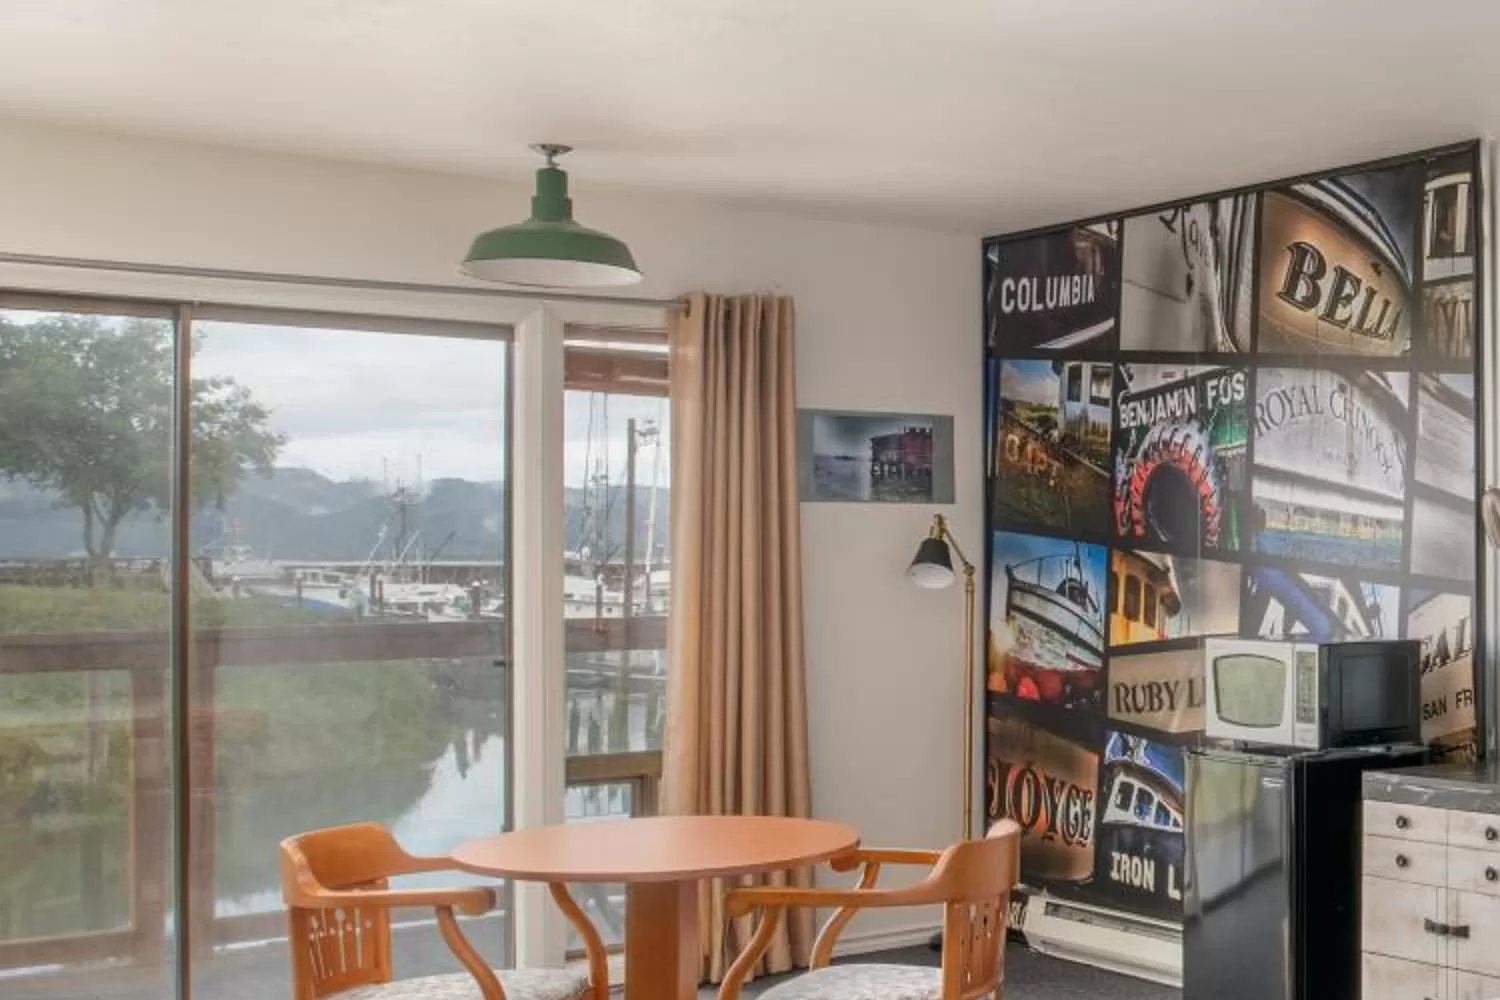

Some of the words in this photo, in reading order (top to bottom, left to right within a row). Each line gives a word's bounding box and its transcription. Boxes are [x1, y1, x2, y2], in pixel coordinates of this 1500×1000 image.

[1001, 274, 1095, 314] COLUMBIA
[1119, 386, 1197, 429] BENJAMIN
[1206, 371, 1245, 411] FOS
[1253, 384, 1324, 437] ROYAL
[1113, 681, 1181, 714] RUBY
[1423, 693, 1447, 720] SAN
[1110, 851, 1155, 893] IRON
[1167, 864, 1181, 901] L
